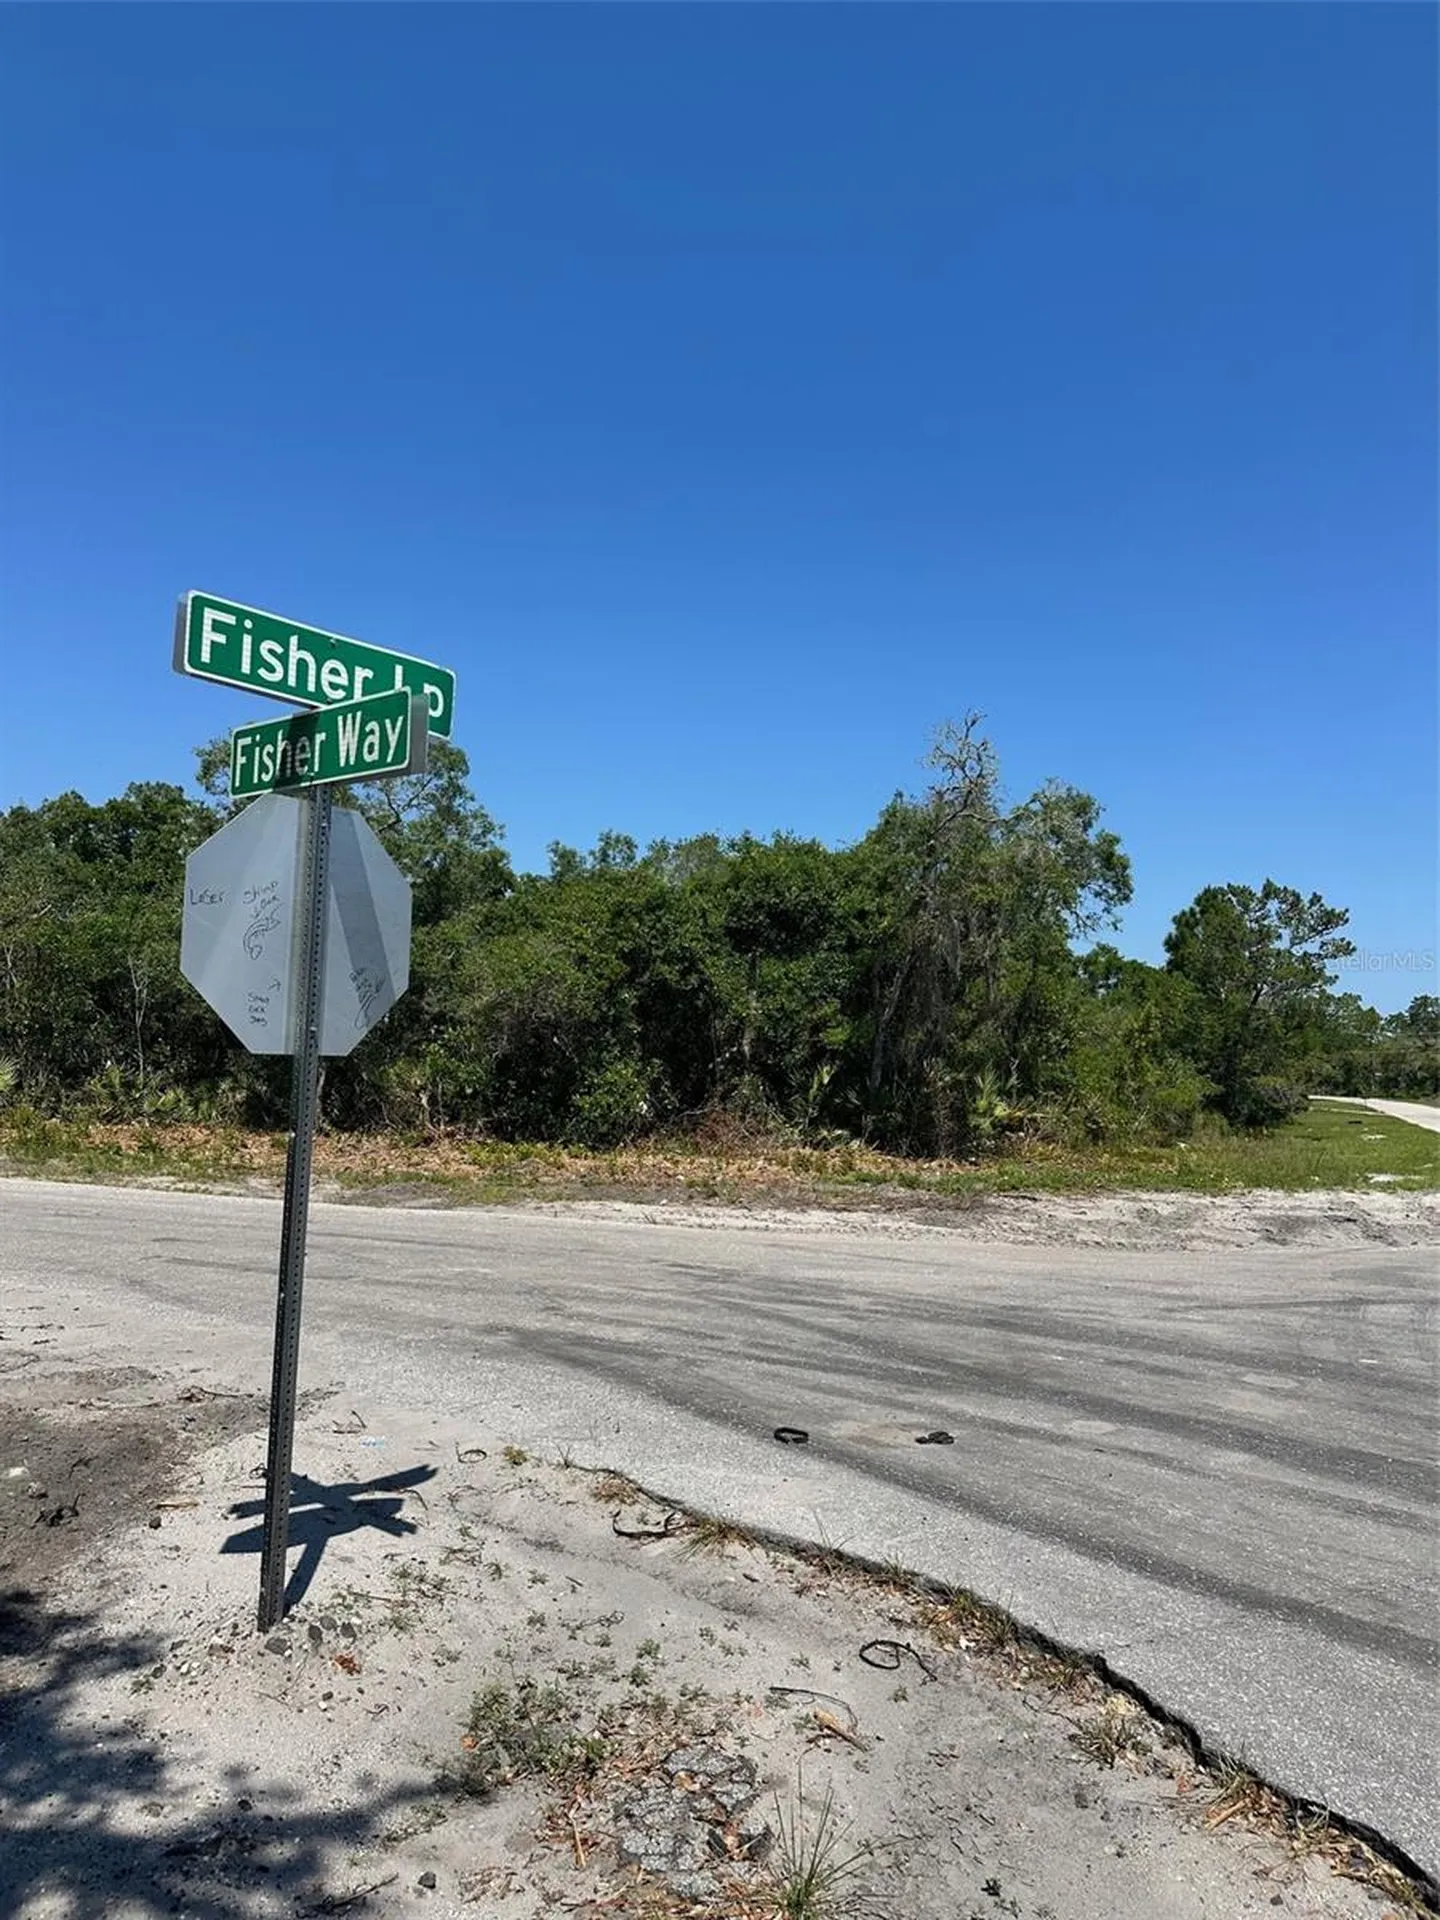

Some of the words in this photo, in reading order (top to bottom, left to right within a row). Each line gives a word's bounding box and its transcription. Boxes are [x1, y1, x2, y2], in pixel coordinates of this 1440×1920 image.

[200, 606, 374, 702] Fisher
[234, 729, 327, 788] Fisher
[336, 710, 404, 768] Way
